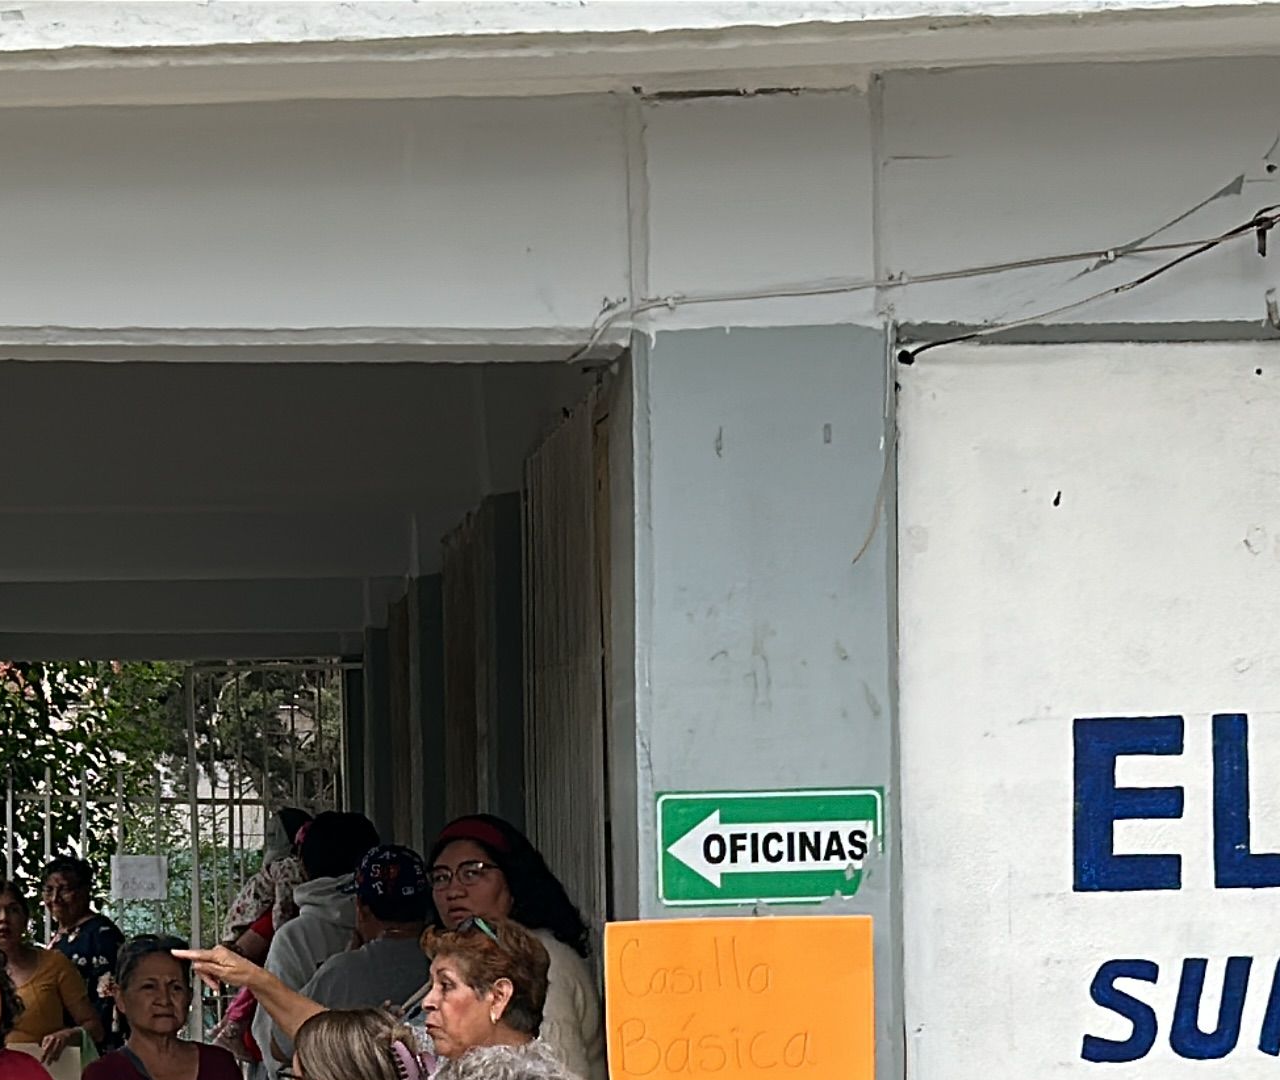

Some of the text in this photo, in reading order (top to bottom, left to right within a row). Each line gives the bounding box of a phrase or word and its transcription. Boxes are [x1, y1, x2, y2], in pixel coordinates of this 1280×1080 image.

[702, 830, 868, 865] OFICINAS
[618, 935, 771, 998] Casilla
[616, 1011, 818, 1076] Básica
